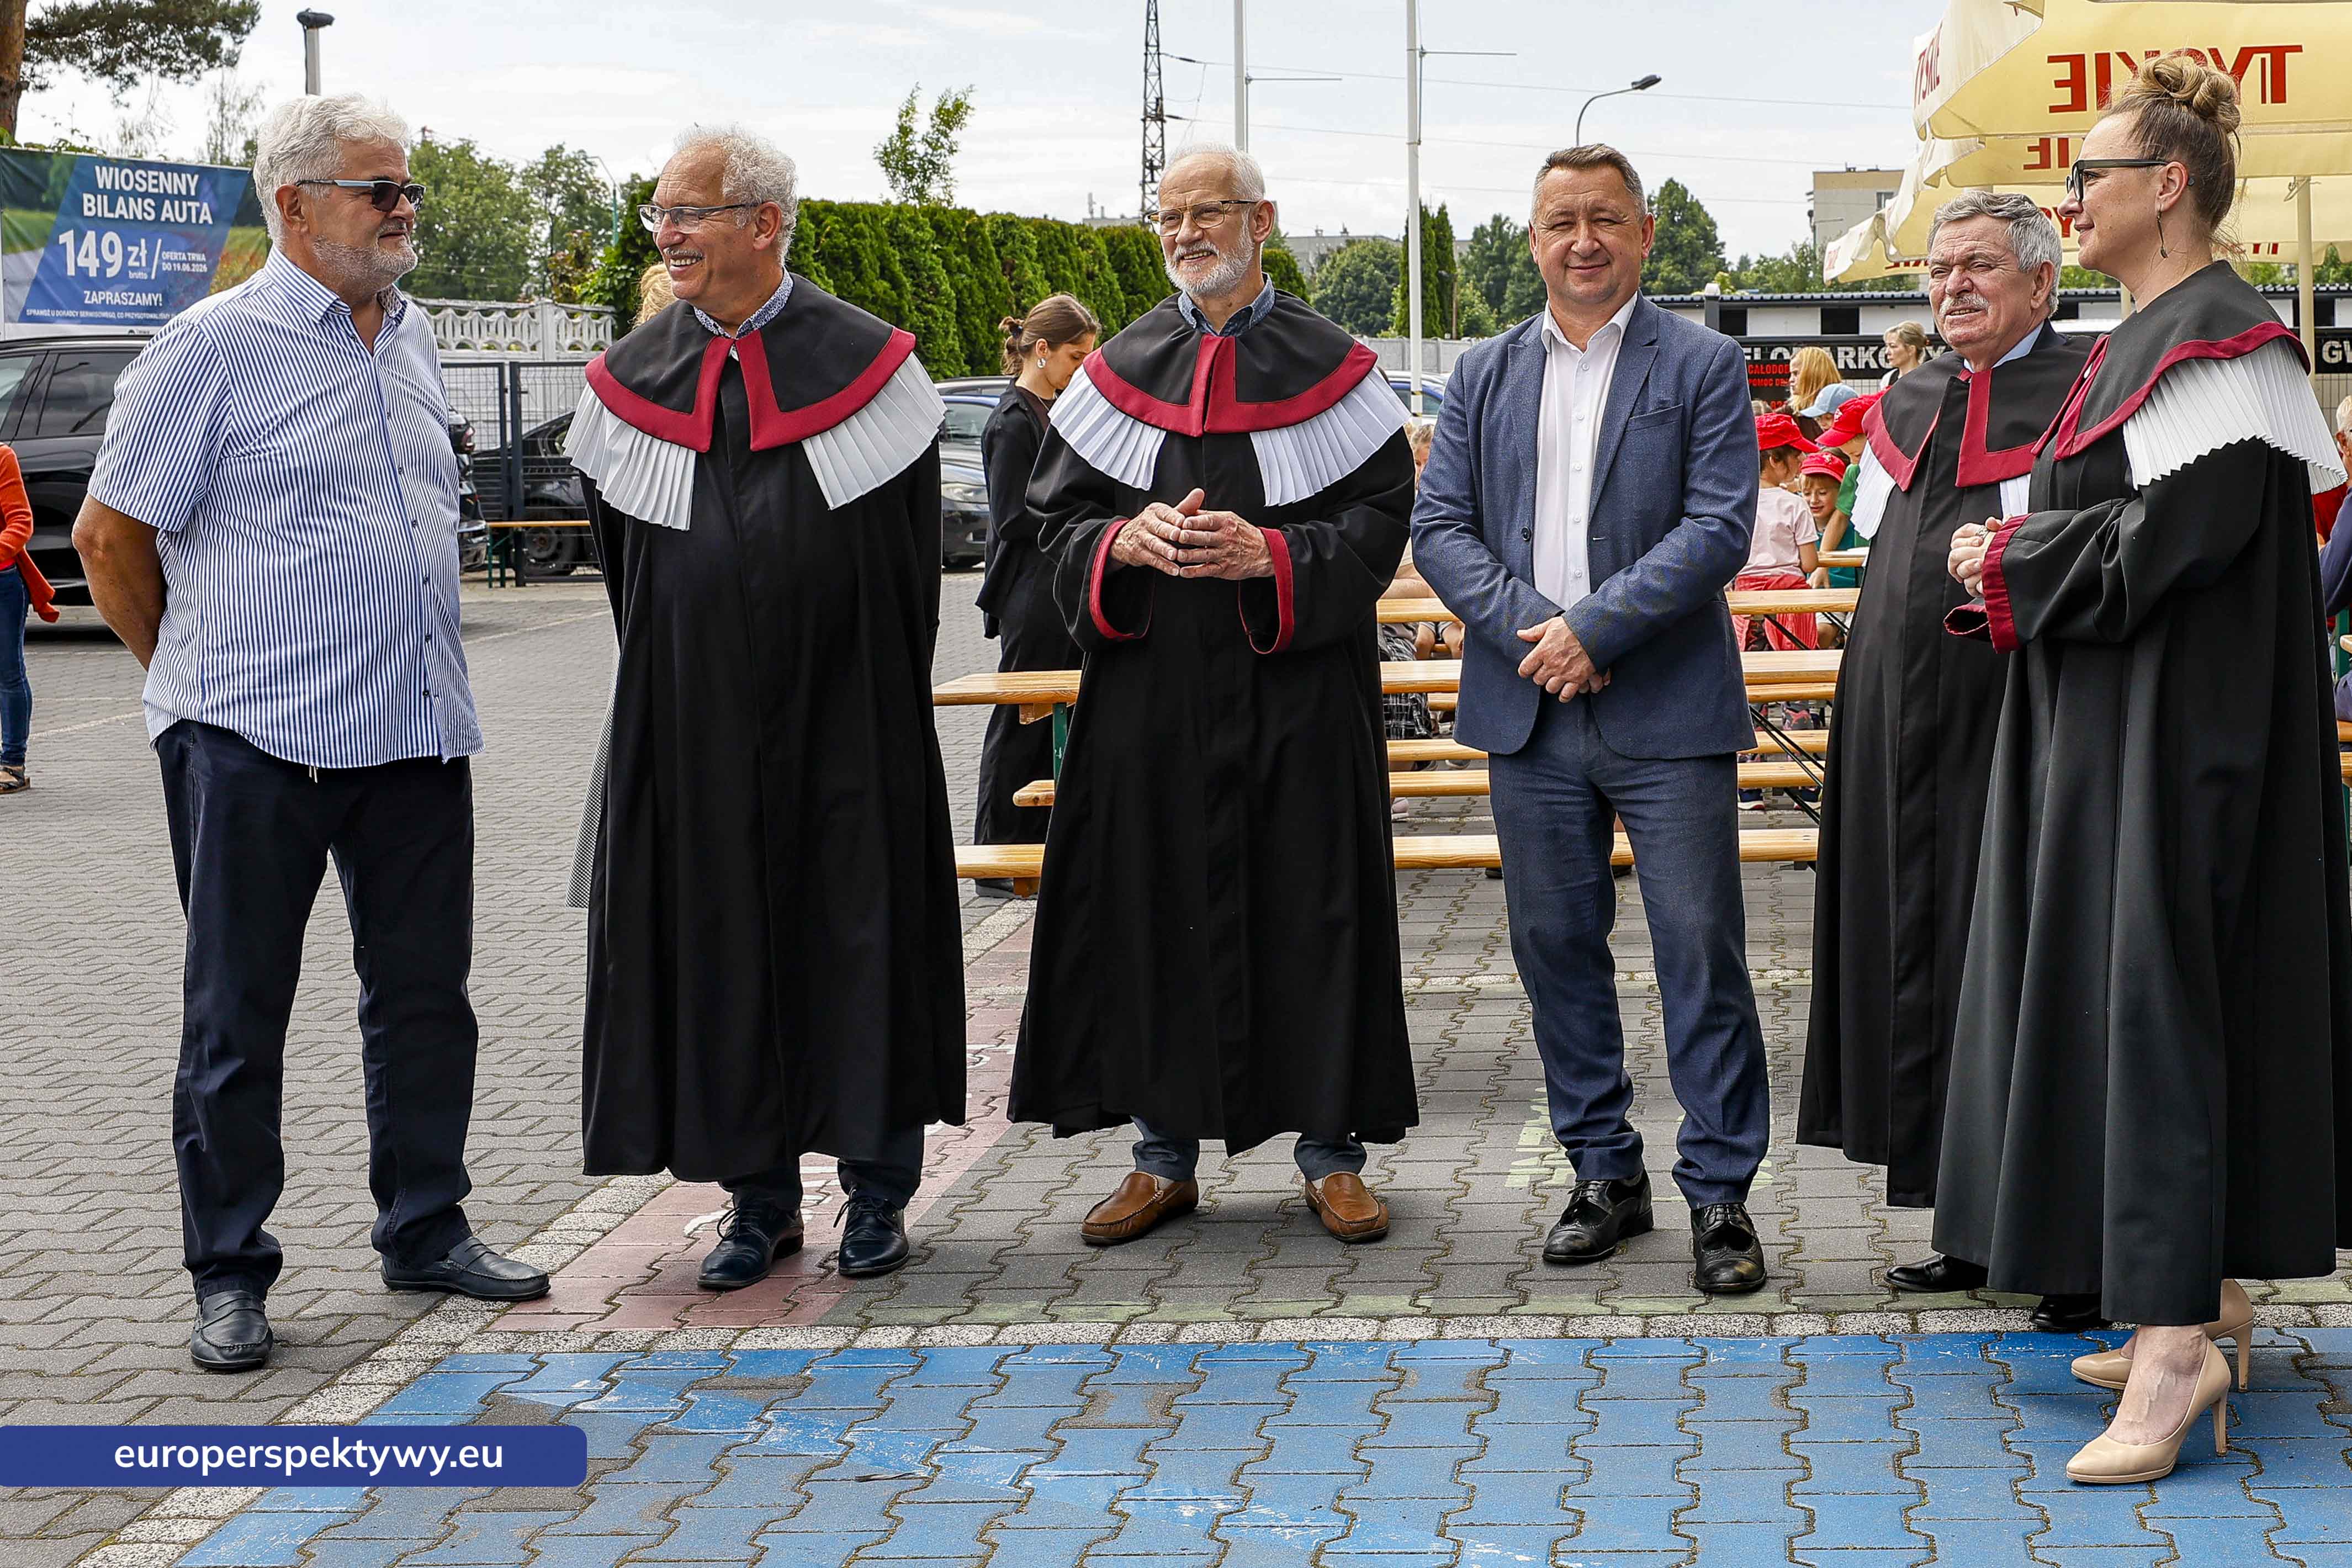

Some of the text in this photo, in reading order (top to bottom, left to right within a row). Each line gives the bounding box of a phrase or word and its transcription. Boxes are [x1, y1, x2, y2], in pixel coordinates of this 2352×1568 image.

[95, 165, 199, 196] WIOSENNY
[83, 193, 213, 225] BILANS AUTA
[59, 229, 147, 278] 149 zł
[162, 251, 206, 262] OFERTA TRWA
[162, 262, 172, 271] DO
[84, 290, 163, 307] ZAPRASZAMY!
